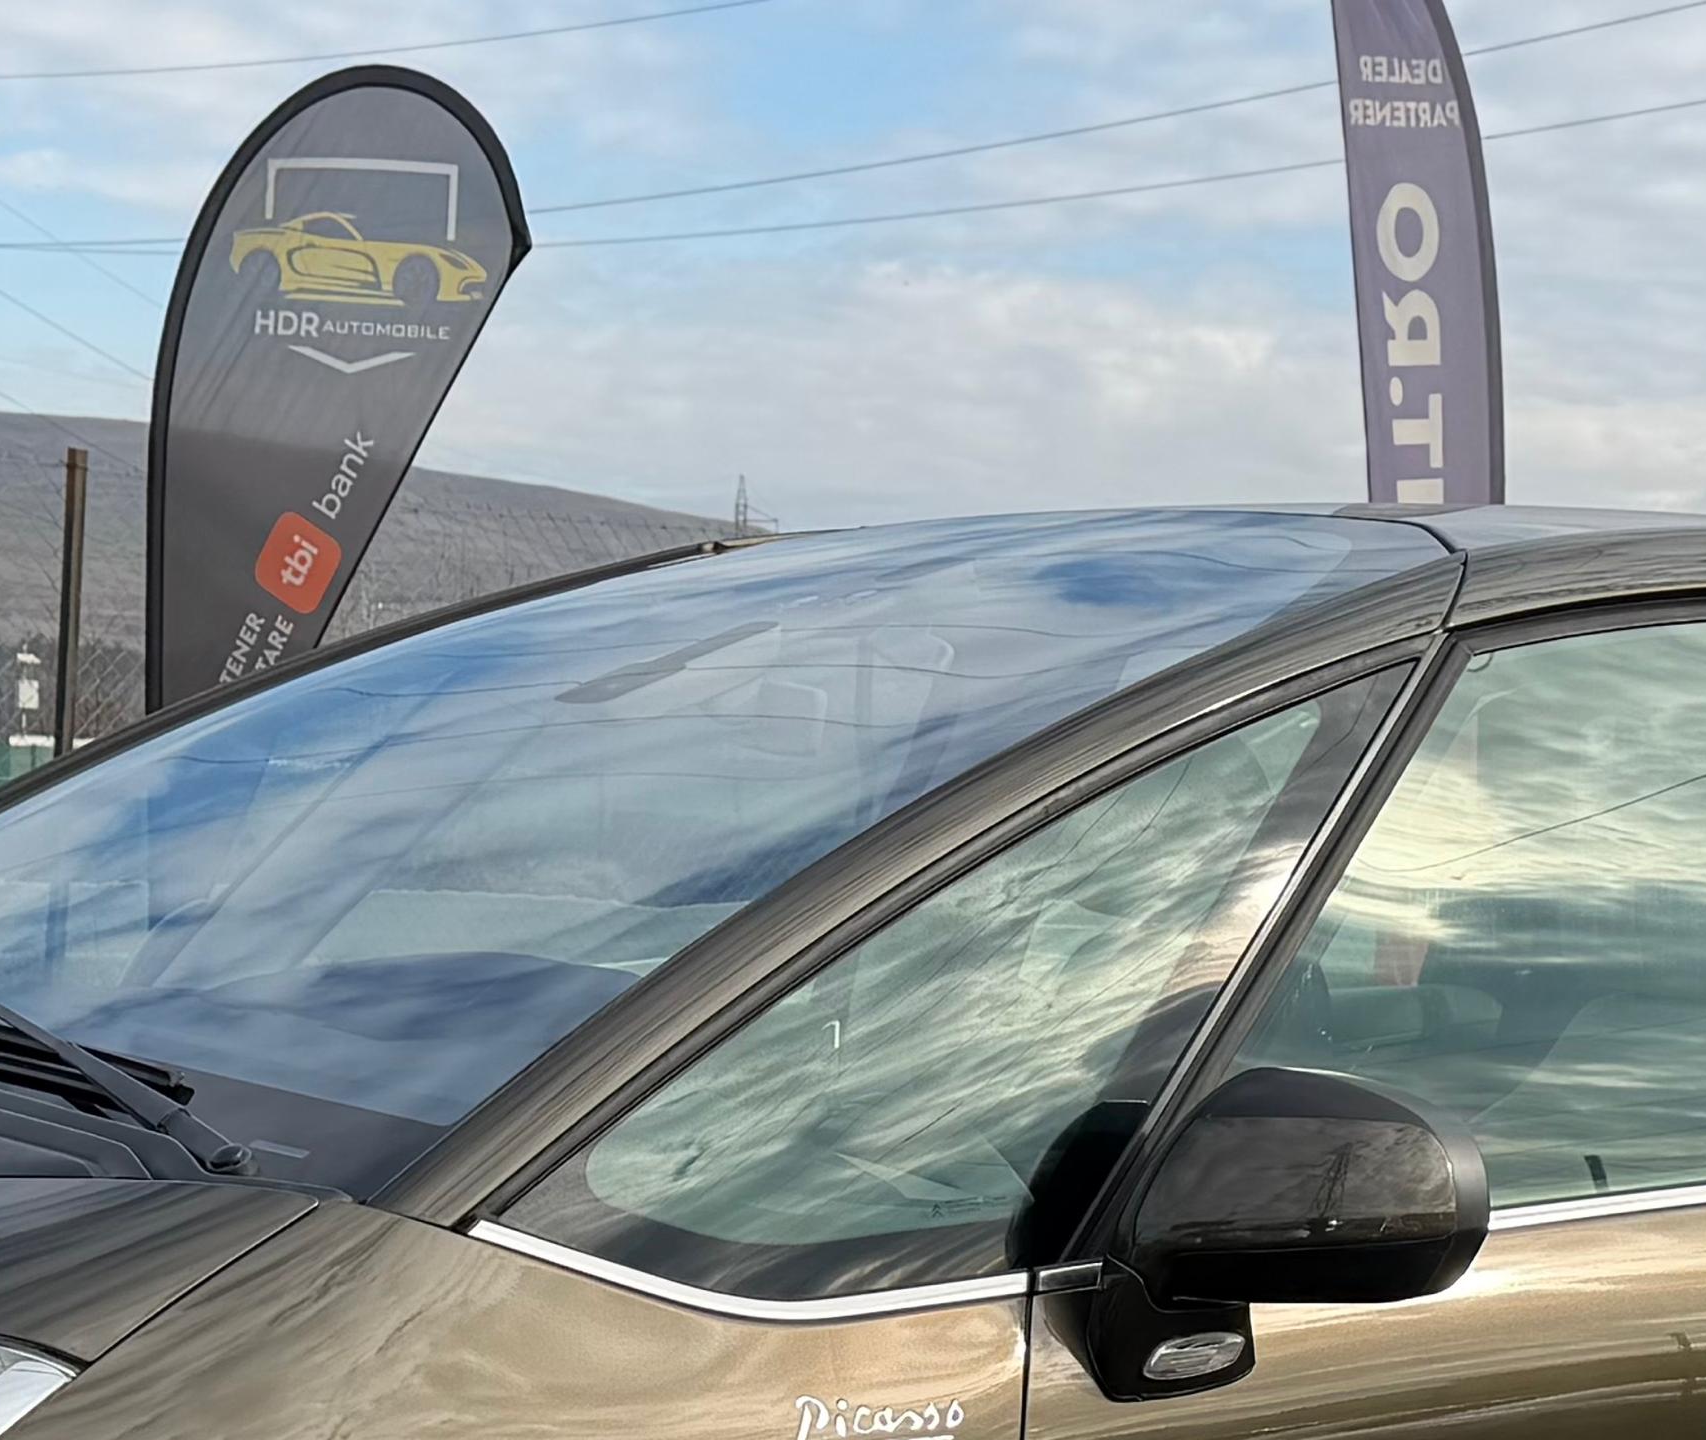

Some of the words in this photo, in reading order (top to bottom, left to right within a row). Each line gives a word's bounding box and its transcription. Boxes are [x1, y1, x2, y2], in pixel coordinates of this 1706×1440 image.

[254, 309, 320, 338] HDR
[322, 319, 451, 340] AUTOMOBILE
[280, 534, 318, 586] tbi
[311, 431, 374, 520] bank
